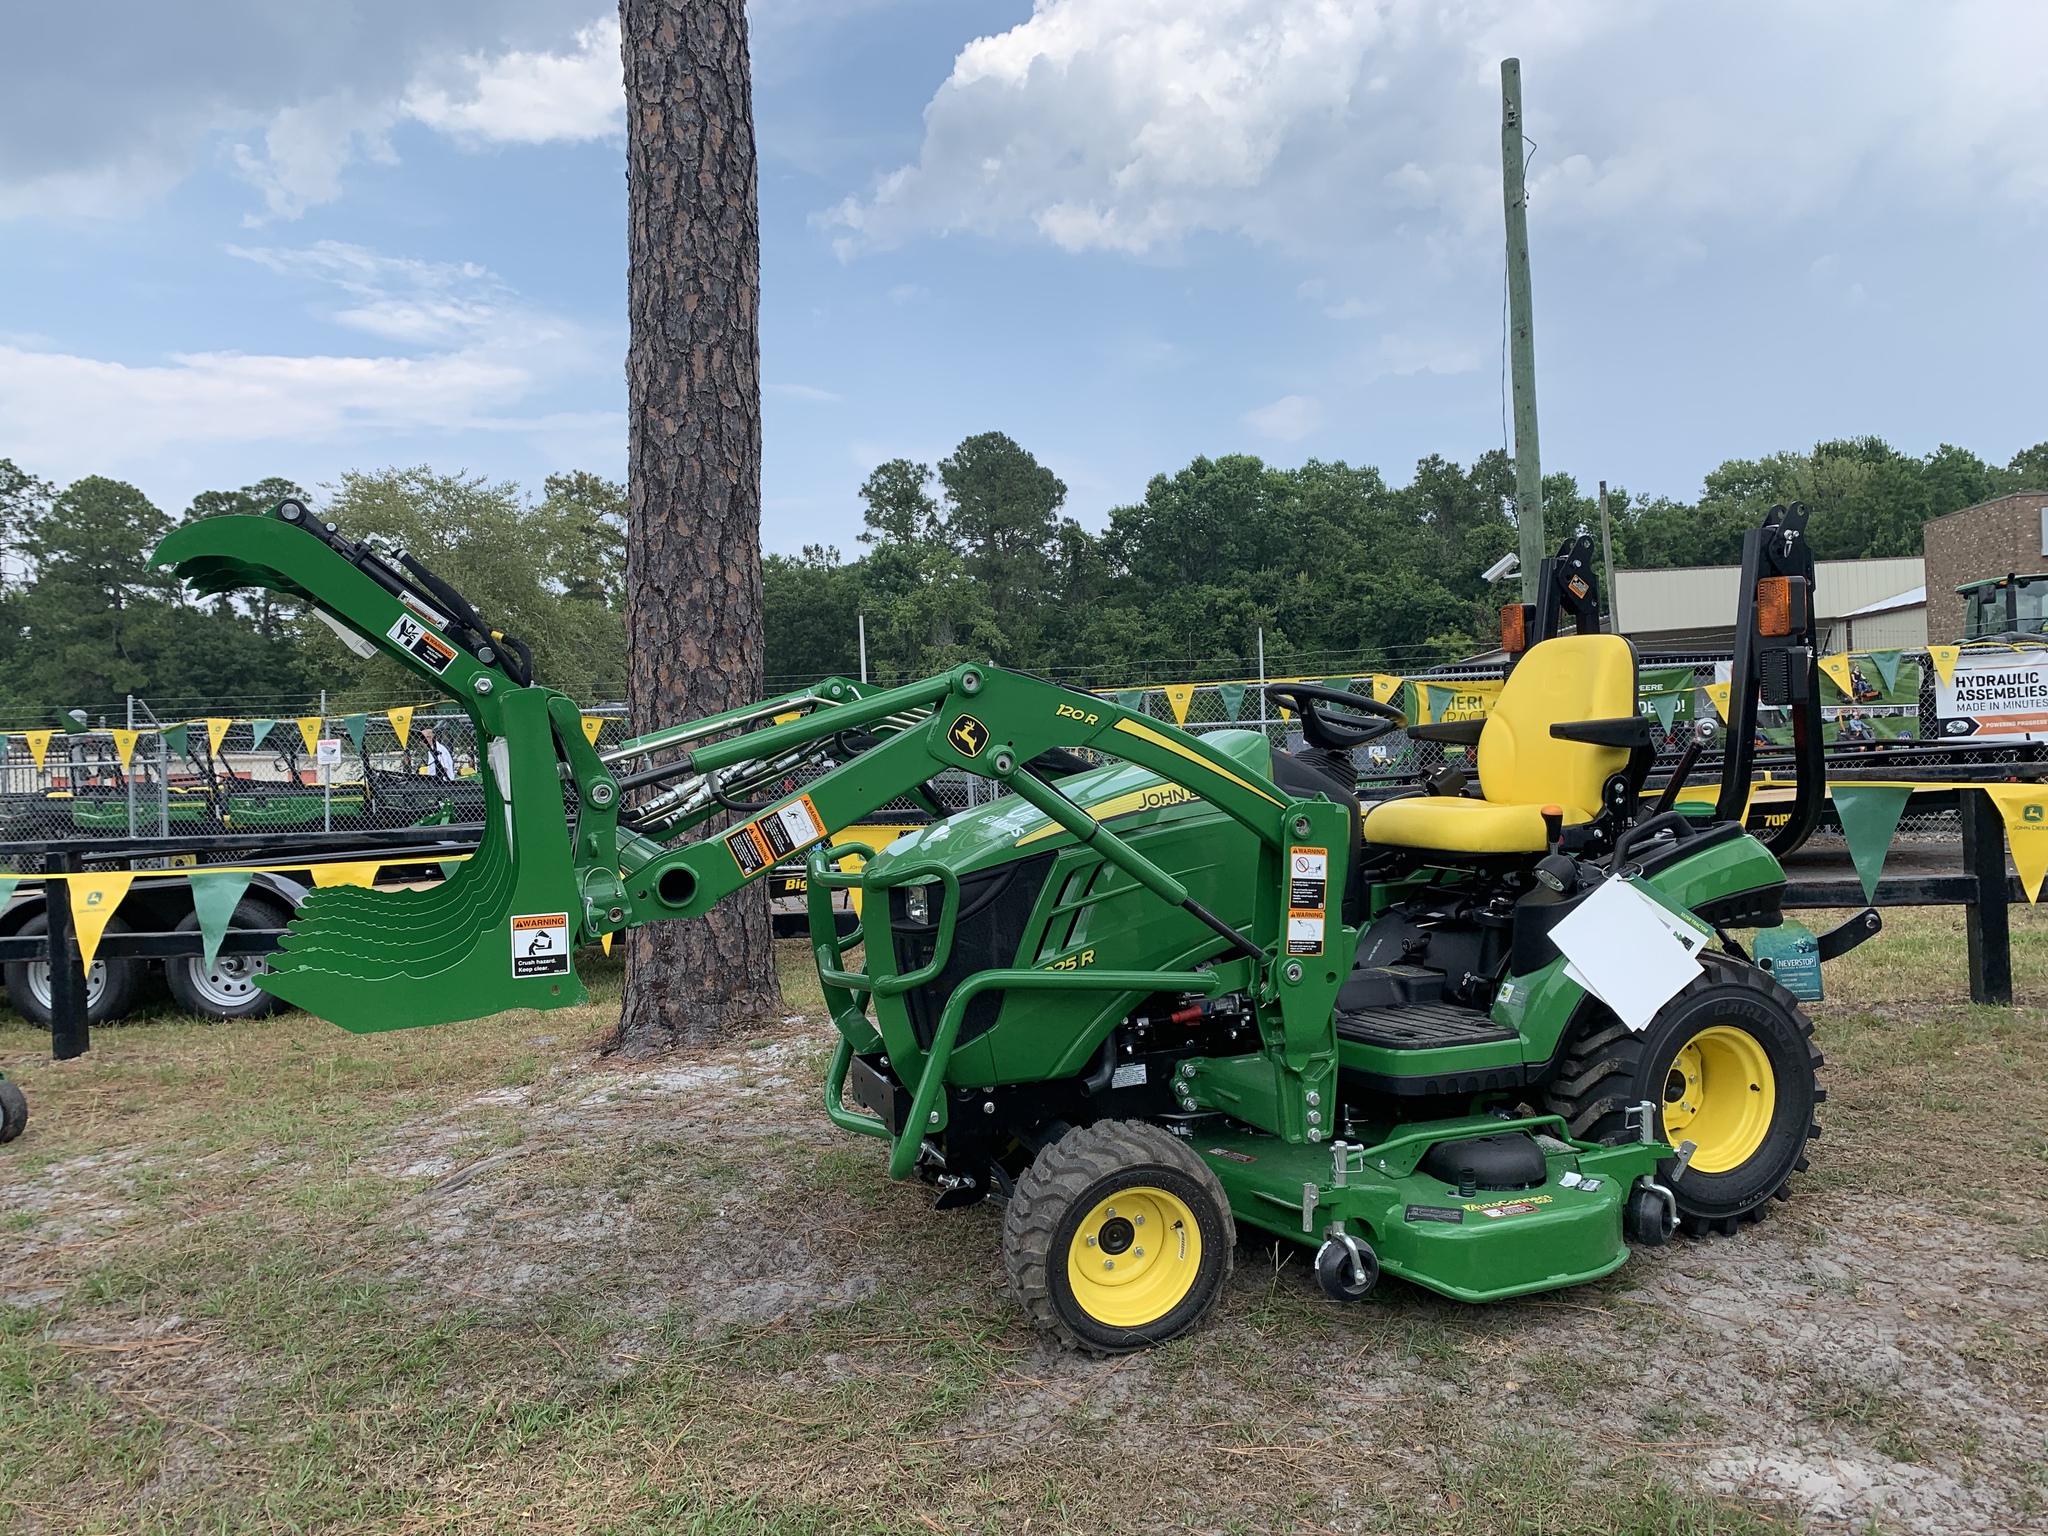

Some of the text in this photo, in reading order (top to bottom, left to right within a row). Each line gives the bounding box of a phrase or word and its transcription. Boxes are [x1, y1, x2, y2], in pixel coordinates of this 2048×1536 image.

[429, 637, 453, 657] WARNING
[1956, 672, 2039, 688] HYDRAULIC
[1956, 685, 2048, 701] ASSEMBLIES
[1957, 699, 2048, 712] MADE IN MINUTES
[1055, 703, 1099, 726] 120 R
[1985, 720, 2017, 728] POWERING
[1138, 788, 1185, 811] JOHN
[808, 805, 823, 832] WARNING
[753, 835, 770, 861] WARNING
[785, 878, 808, 891] Big
[522, 918, 564, 927] WARNING
[1043, 950, 1095, 970] 25 R
[1778, 958, 1814, 968] NEVERSTOP
